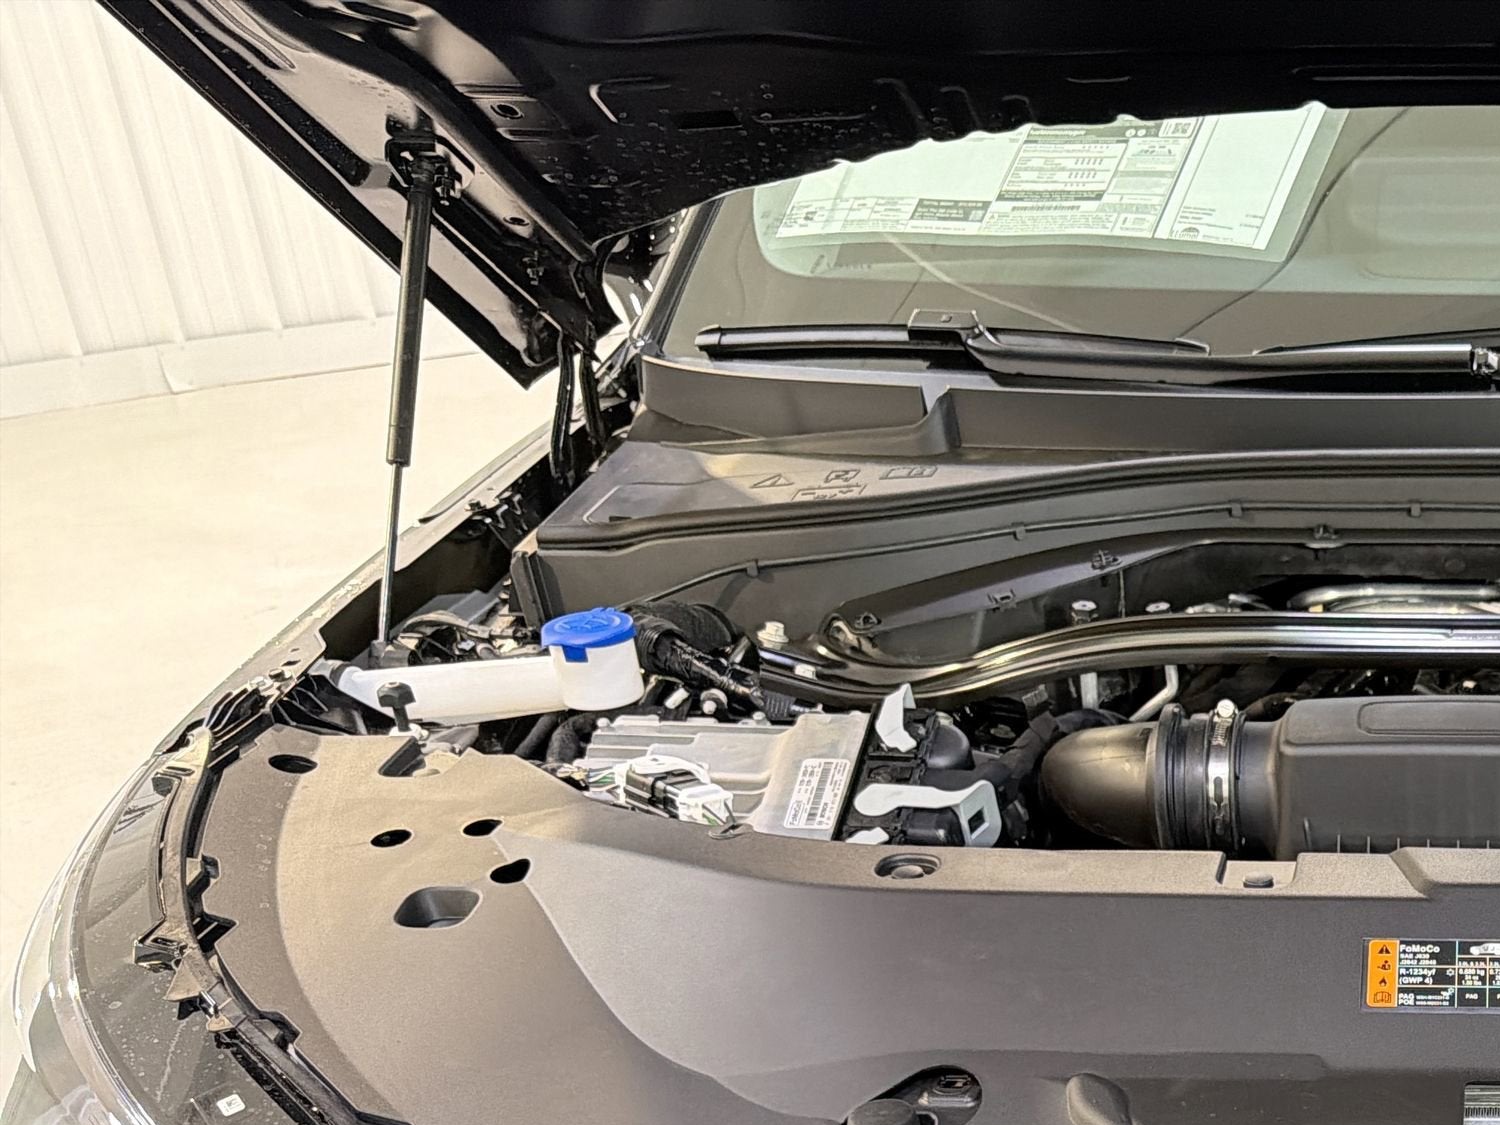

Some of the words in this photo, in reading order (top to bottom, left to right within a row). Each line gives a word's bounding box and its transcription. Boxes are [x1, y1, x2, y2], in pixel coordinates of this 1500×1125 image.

[1400, 944, 1440, 953] FoMoCo
[1400, 968, 1436, 976] R-1234yf
[1399, 976, 1423, 985] (GWP
[1424, 976, 1433, 985] 4)
